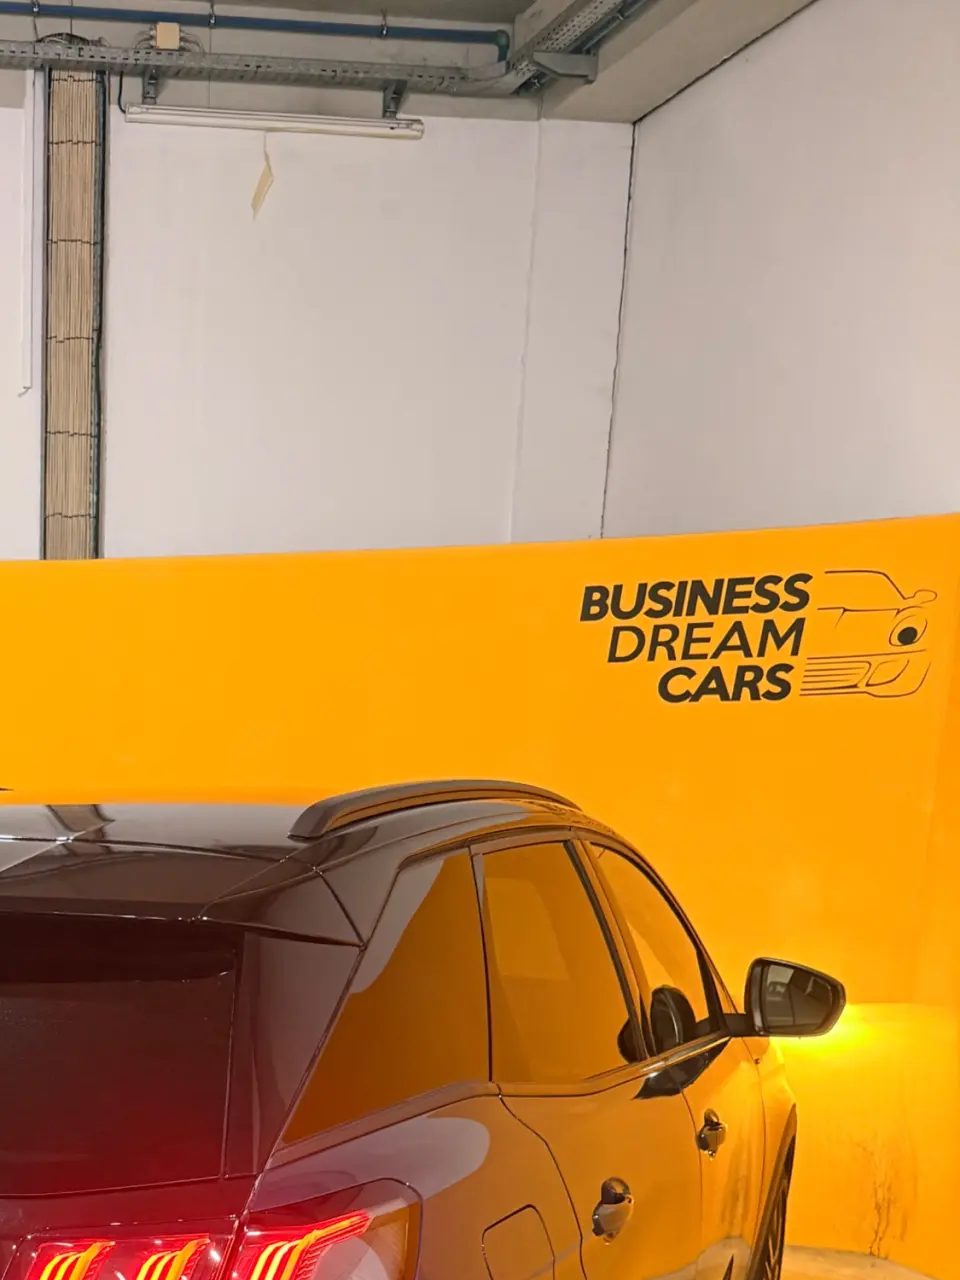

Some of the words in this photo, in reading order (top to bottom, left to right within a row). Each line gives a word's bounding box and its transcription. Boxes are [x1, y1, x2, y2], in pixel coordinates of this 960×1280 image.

[580, 573, 813, 622] BUSINESS
[607, 617, 806, 663] DREAM
[658, 663, 794, 703] CARS
